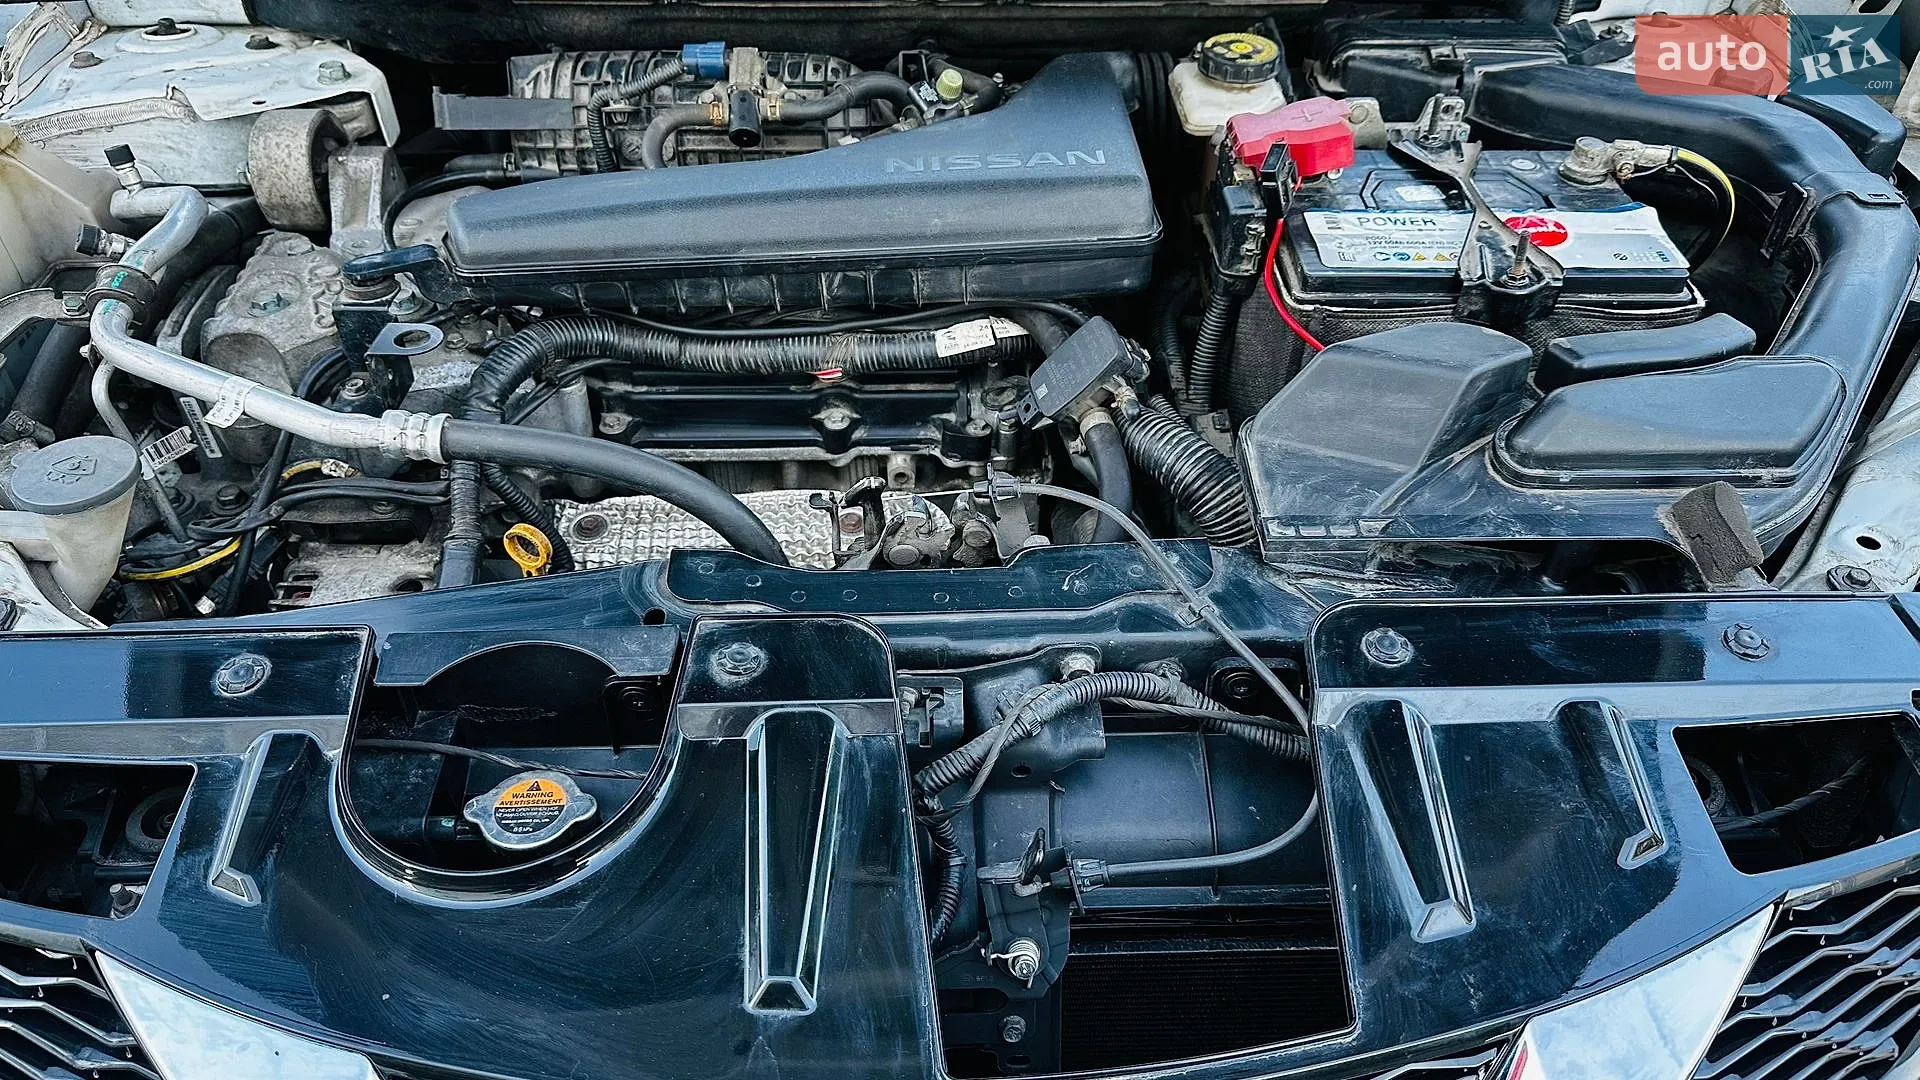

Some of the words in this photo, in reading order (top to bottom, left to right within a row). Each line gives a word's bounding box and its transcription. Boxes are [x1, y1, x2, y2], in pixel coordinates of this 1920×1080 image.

[884, 149, 1106, 173] NISSAN
[1357, 217, 1436, 226] POWER
[499, 798, 562, 806] AVERTISSEMENT
